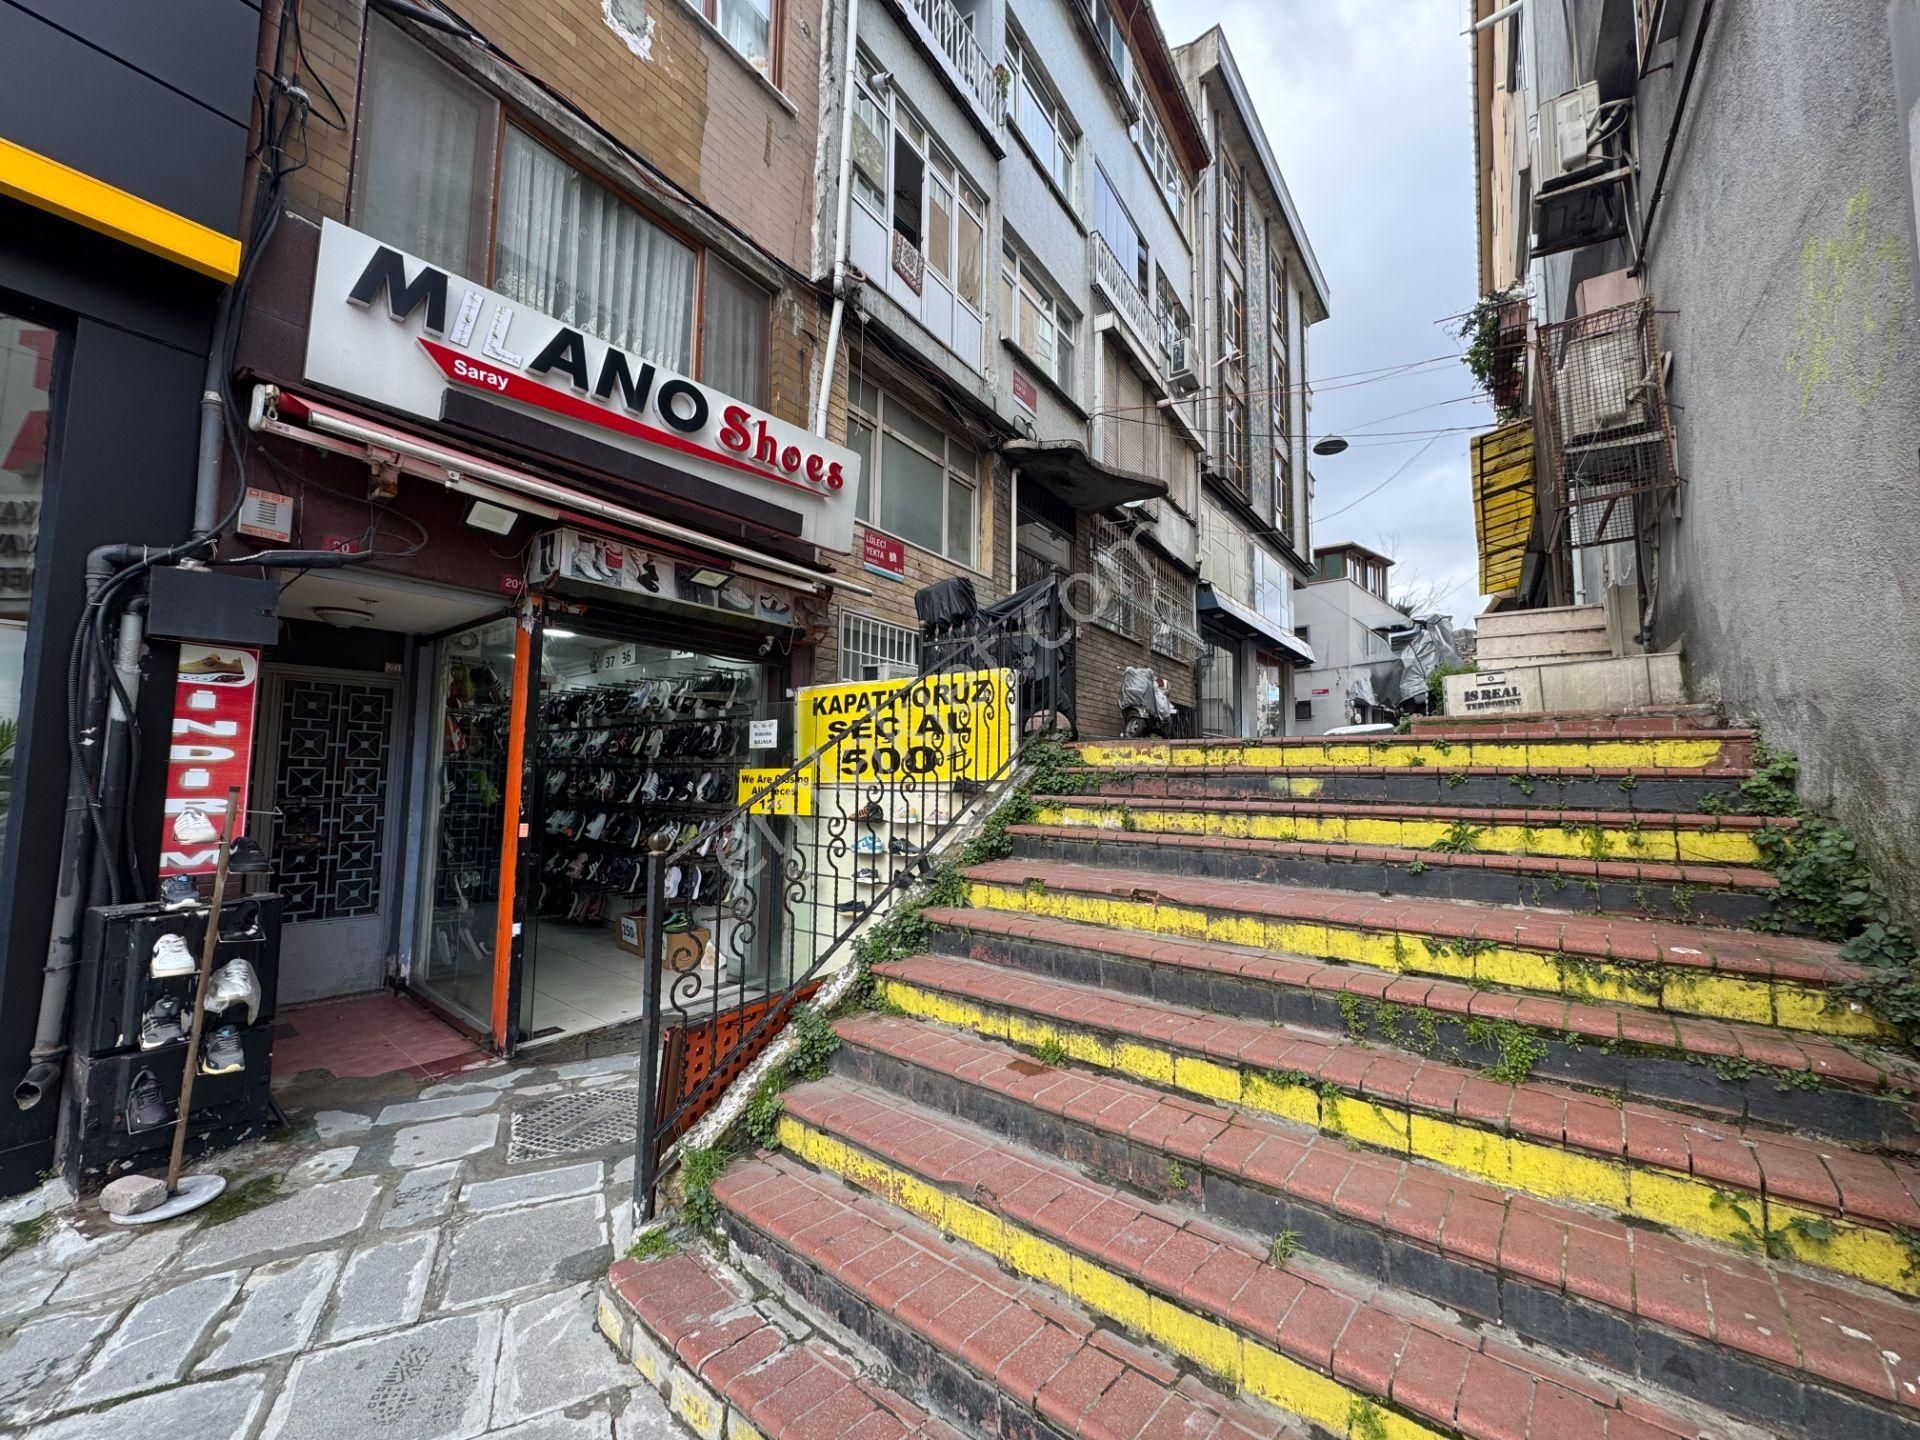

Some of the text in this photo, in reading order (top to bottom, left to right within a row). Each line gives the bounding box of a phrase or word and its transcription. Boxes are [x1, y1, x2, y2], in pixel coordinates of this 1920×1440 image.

[345, 245, 844, 491] MILANO Shoes
[453, 357, 510, 391] Saray
[866, 545, 885, 560] YEKTA
[606, 655, 616, 669] 37
[622, 649, 632, 665] 36
[1481, 686, 1521, 701] REAL
[1465, 698, 1522, 711] TERRORIST
[827, 712, 972, 744] SEÇ AL
[741, 774, 755, 784] We
[757, 774, 772, 784] Are
